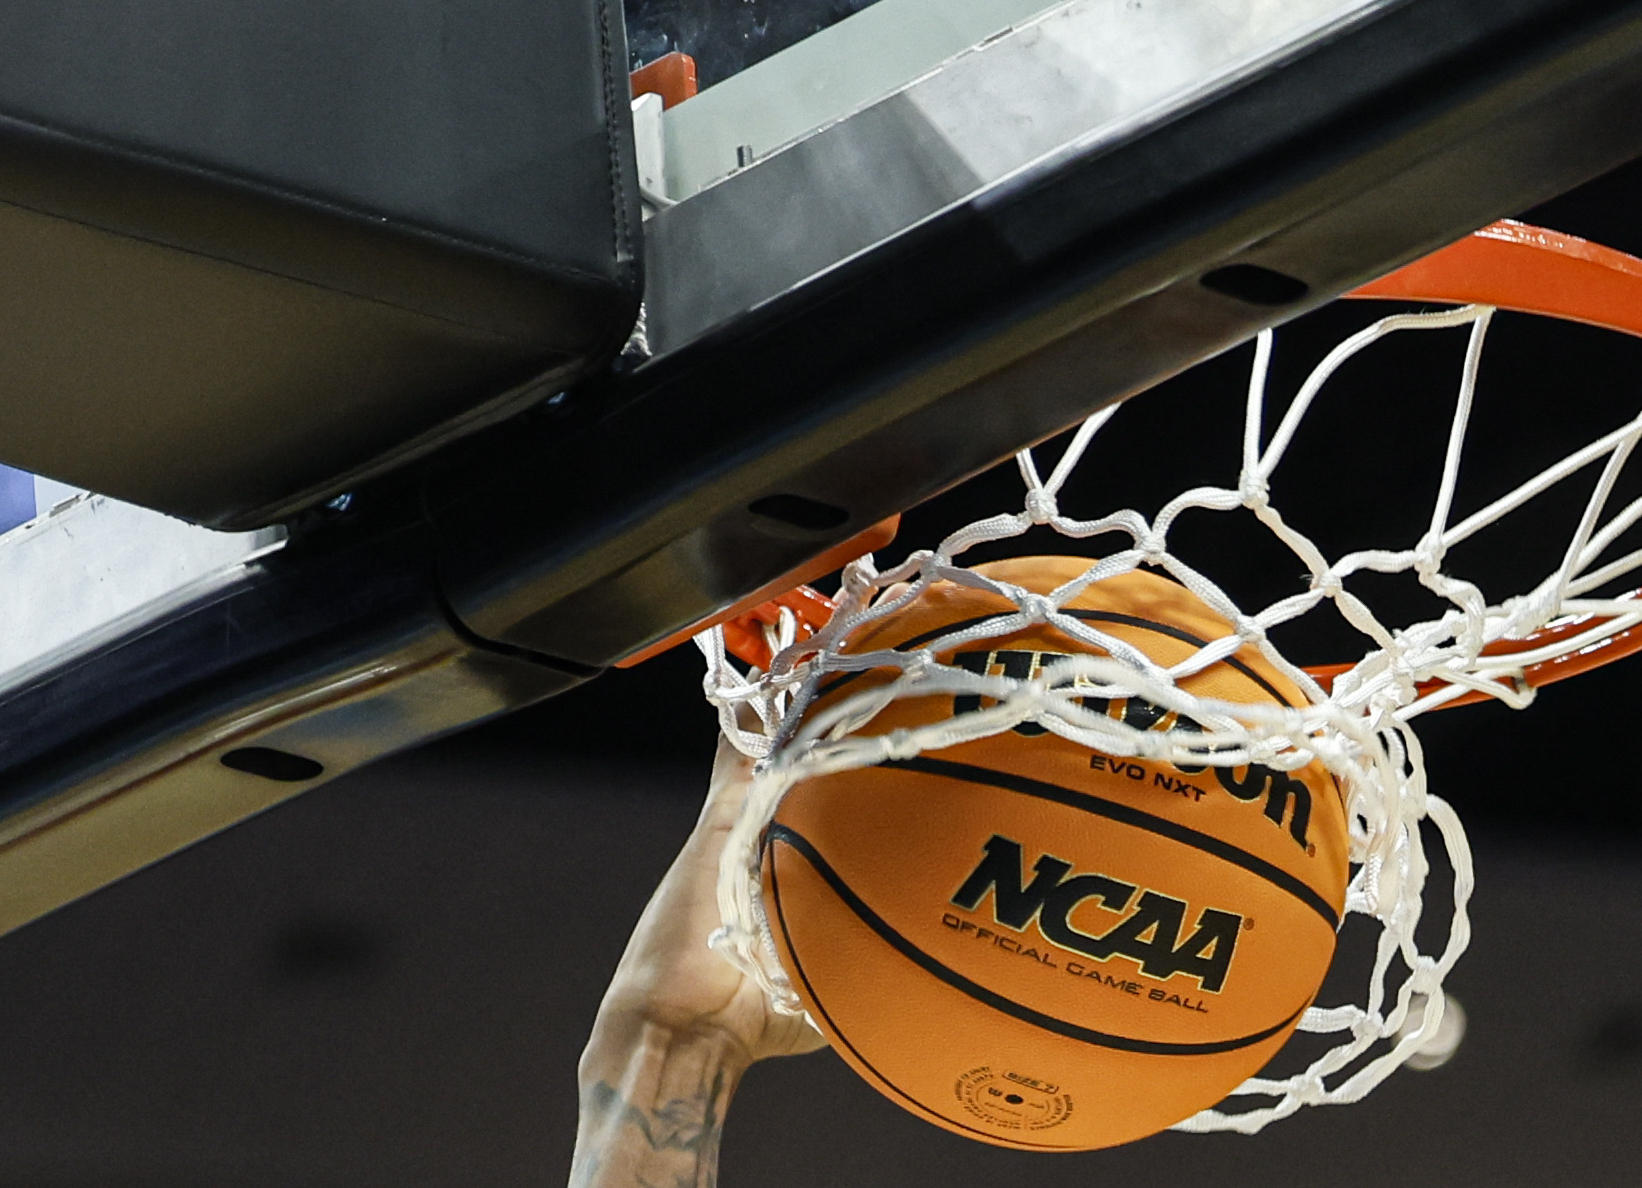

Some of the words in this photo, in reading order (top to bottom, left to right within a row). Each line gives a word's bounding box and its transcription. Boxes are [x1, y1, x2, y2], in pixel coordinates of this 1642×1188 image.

[1089, 754, 1147, 781] EVO
[1154, 772, 1207, 803] NXT
[941, 912, 1057, 969] OFFICIAL
[1065, 962, 1141, 997] GAME
[1148, 989, 1209, 1014] BALL
[949, 833, 1245, 995] NCAA
